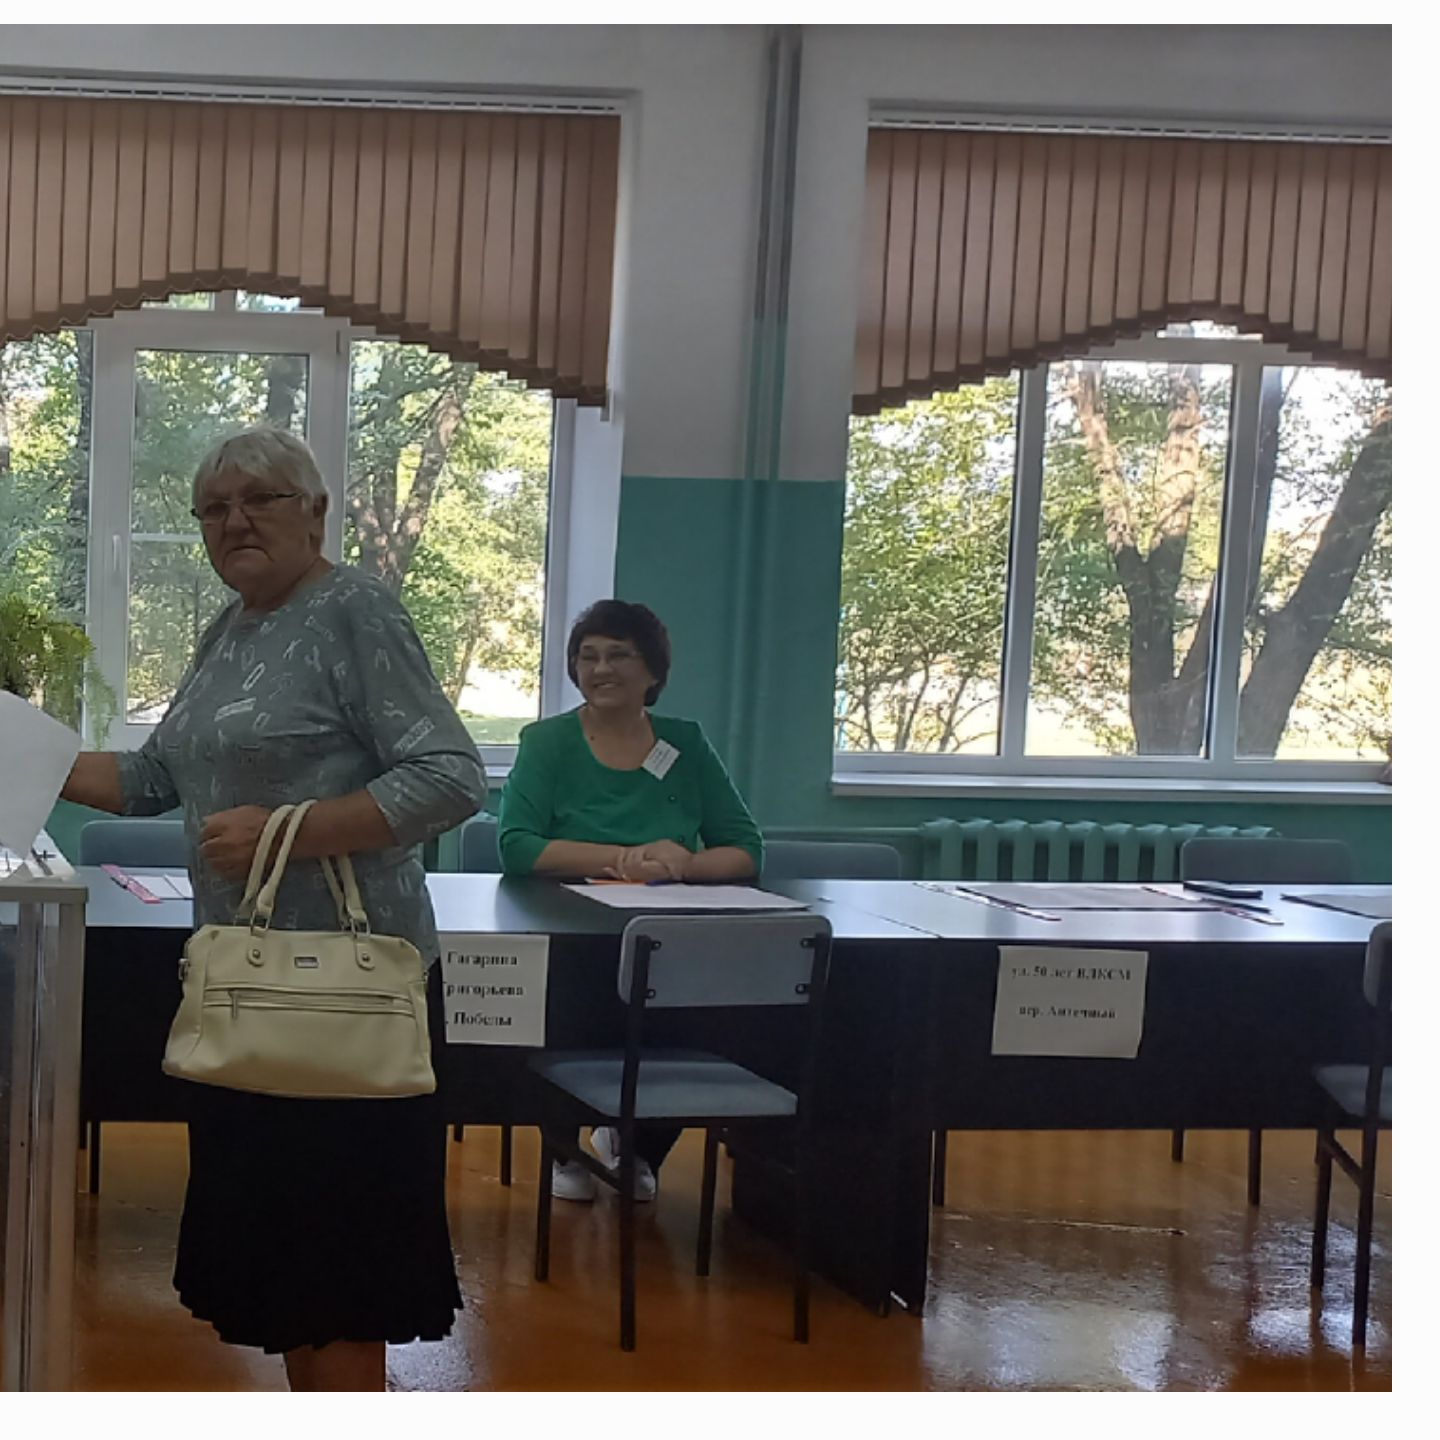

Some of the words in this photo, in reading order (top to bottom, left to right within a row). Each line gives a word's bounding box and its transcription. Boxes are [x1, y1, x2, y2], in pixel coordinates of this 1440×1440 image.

[447, 951, 518, 969] Гагарина
[1033, 966, 1048, 977] 50
[1076, 968, 1132, 981] ВЛКСМ
[442, 980, 524, 998] ригорьева
